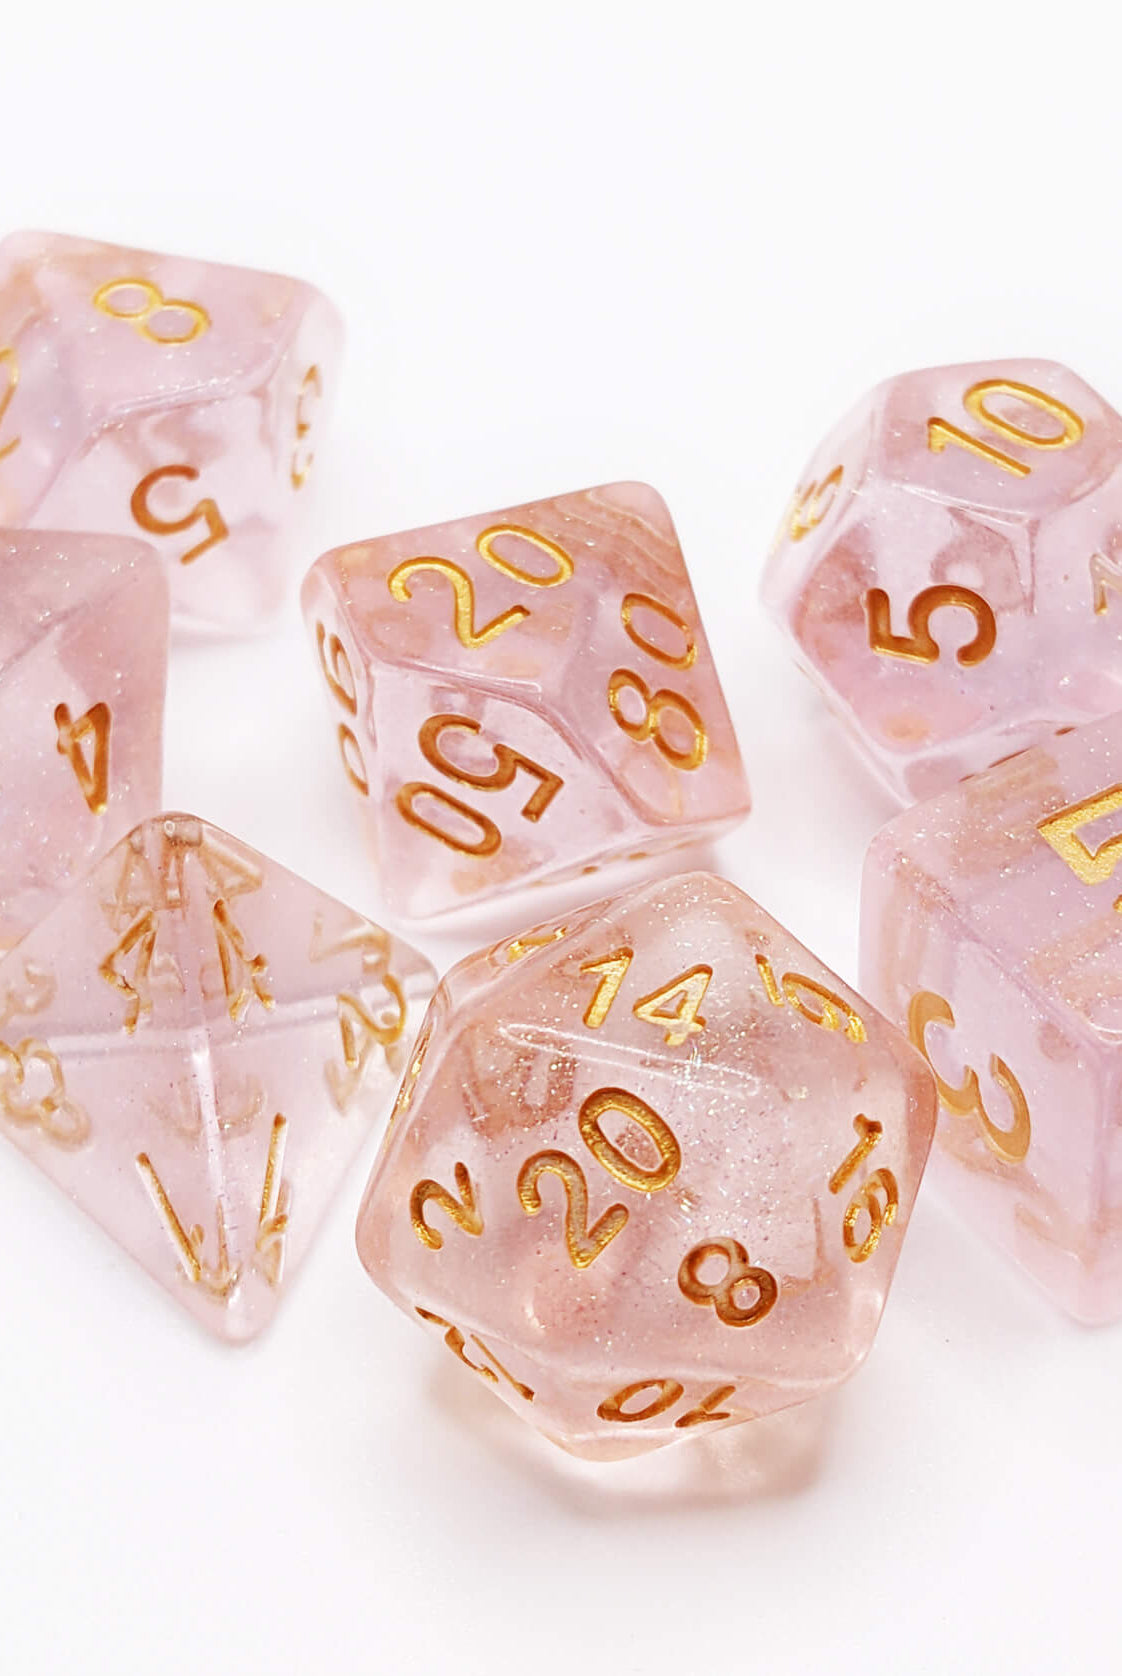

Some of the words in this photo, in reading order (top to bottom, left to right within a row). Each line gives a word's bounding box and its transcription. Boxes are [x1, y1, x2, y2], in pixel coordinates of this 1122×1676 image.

[92, 277, 212, 345] 8
[927, 378, 1085, 479] 10
[130, 464, 229, 565] 5
[388, 524, 575, 649] 20
[866, 585, 997, 667] 5
[608, 593, 709, 771] 80
[396, 714, 564, 858] 50
[579, 947, 713, 1046] 14
[907, 990, 1030, 1164] 3
[409, 1161, 484, 1250] 2
[517, 1087, 682, 1268] 20
[828, 1113, 900, 1263] 16
[677, 1237, 780, 1328] 8
